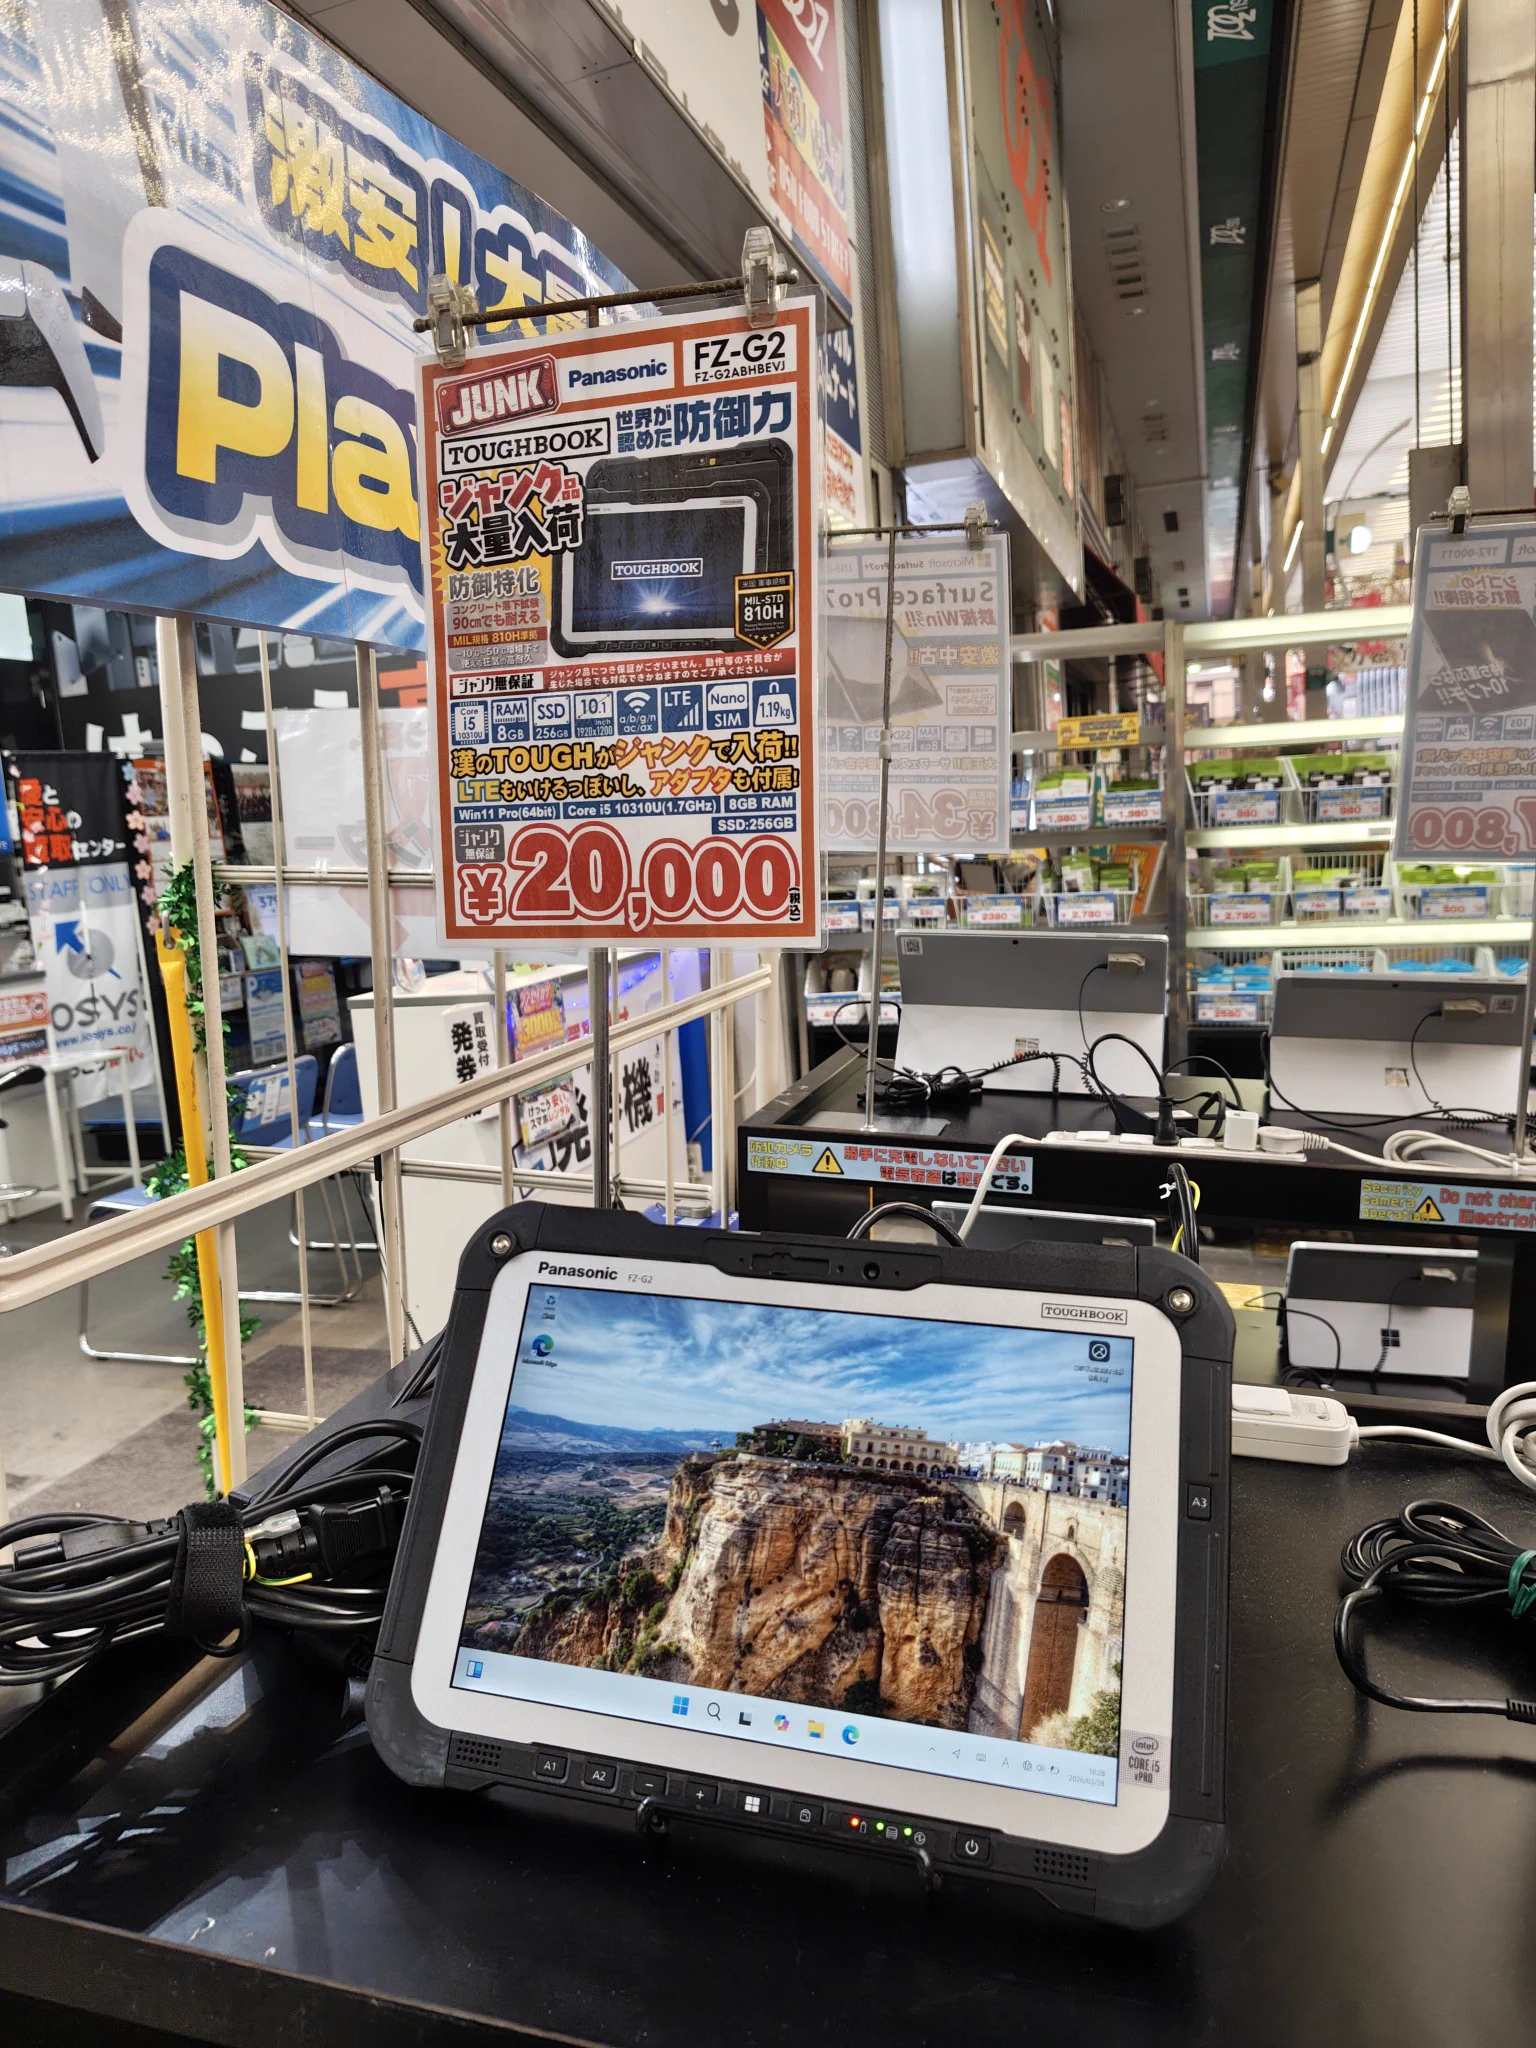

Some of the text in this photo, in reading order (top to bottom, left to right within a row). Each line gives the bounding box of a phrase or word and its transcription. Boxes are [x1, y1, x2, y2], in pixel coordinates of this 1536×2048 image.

[694, 331, 786, 370] FZ-G2
[569, 358, 668, 389] Panasonic
[694, 360, 786, 383] FZ-G2ABHBEVJ
[452, 368, 544, 426] JUNK
[616, 404, 672, 431] 世界が
[674, 391, 792, 446] 防御力
[449, 428, 604, 466] TOUGHBOOK
[617, 427, 673, 454] 認めた
[442, 463, 581, 520] ジャンク品
[447, 502, 581, 565] 大量入荷
[615, 562, 700, 576] TOUGHBOOK
[449, 566, 541, 602] 防御特化
[744, 594, 785, 606] MIL-STD
[744, 603, 785, 622] 810H
[459, 673, 534, 694] ジャンク無保証
[664, 690, 692, 707] LTE
[710, 693, 746, 705] Nano
[460, 707, 479, 716] Core
[496, 704, 525, 717] RAM
[537, 703, 566, 720] SSD
[759, 701, 791, 720] 1.19kg
[463, 717, 476, 731] i5
[619, 714, 657, 725] a/b/g/n
[714, 712, 742, 728] SIM
[458, 732, 483, 740] 10310U
[497, 725, 525, 741] 8GB
[535, 727, 569, 740] 256GB
[576, 725, 613, 738] 1920x1200
[623, 723, 653, 733] ac/ax
[567, 799, 717, 817] Core i5 10310U(1.7GHz)
[728, 795, 793, 811] 8GB RAM
[459, 805, 557, 821] Win11 Pro(64bit)
[717, 816, 794, 832] SSD:256GB
[459, 828, 500, 847] ジャンク
[465, 847, 495, 860] 無保証
[473, 1010, 490, 1068] 買取受付
[749, 1140, 813, 1156] 防犯カメラ
[749, 1156, 788, 1170] 作動中
[1361, 1180, 1424, 1197] Security
[1439, 1187, 1536, 1211] Do not char
[1361, 1207, 1430, 1222] operation
[538, 1261, 653, 1284] Panasonic FZ-G2
[1045, 1306, 1124, 1322] TOUGHBOOK
[1191, 1496, 1208, 1509] A3
[1134, 1739, 1156, 1751] intel
[543, 1760, 557, 1772] A1
[1128, 1755, 1161, 1772] CORE i5
[591, 1769, 607, 1782] A2
[1134, 1771, 1154, 1784] vPRO
